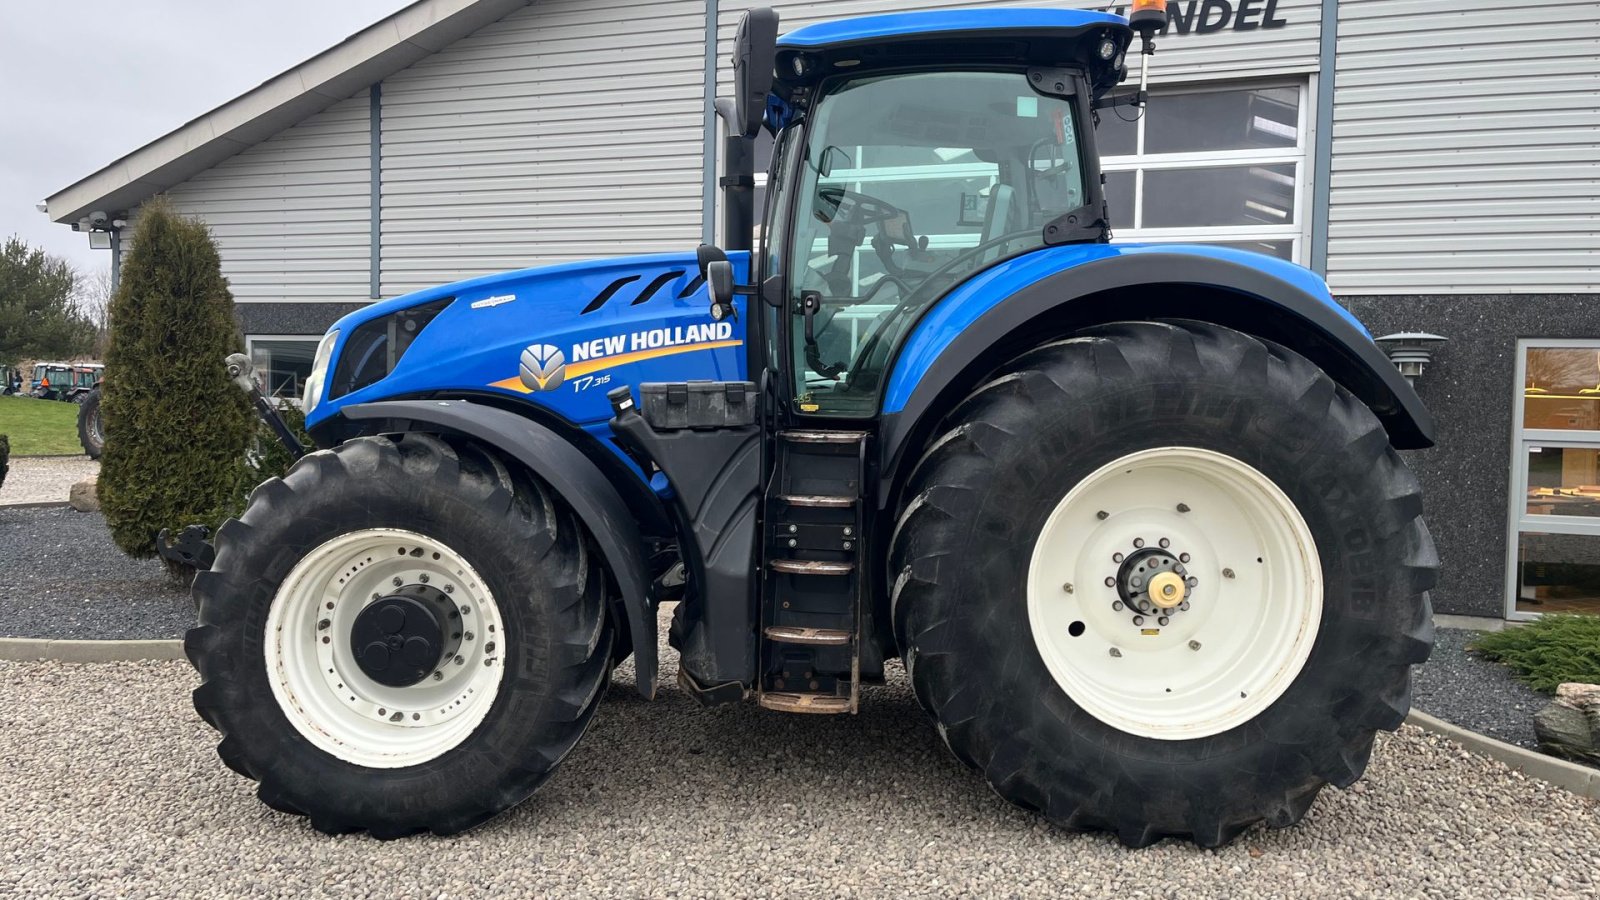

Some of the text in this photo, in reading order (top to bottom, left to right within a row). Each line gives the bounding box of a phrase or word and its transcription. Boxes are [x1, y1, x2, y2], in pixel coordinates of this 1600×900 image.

[1097, 0, 1287, 36] NDEL
[572, 321, 732, 362] NEW HOLLAND
